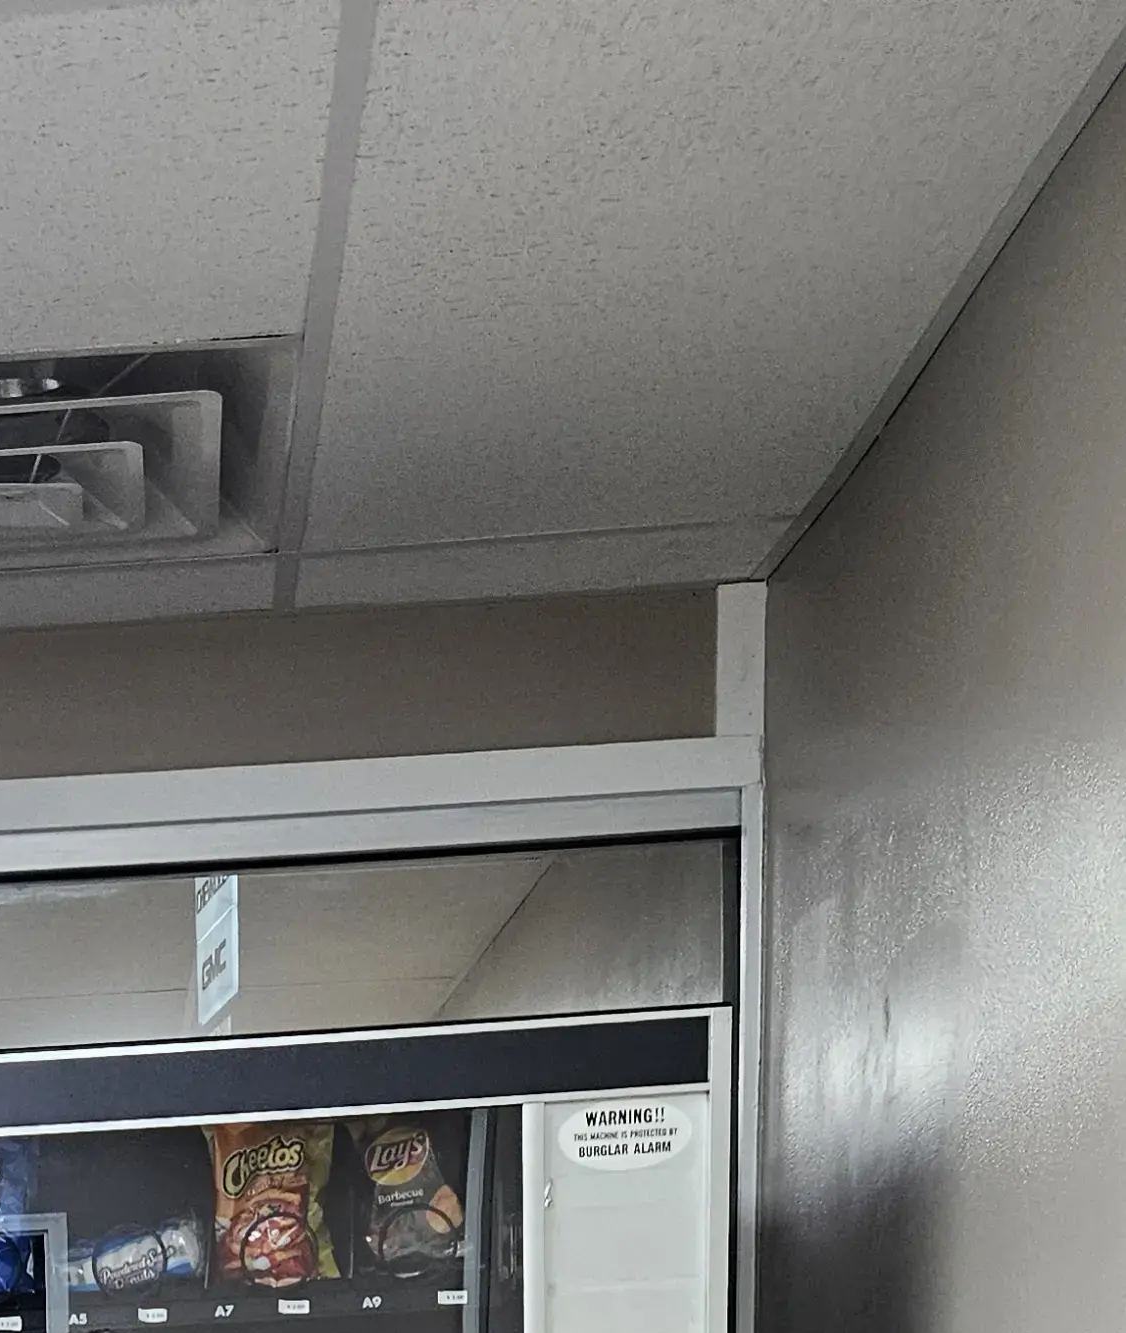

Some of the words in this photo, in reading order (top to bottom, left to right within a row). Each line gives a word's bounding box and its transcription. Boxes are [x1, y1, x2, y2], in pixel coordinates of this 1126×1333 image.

[585, 1107, 666, 1127] WARNING!!
[590, 1132, 619, 1141] MACHINE
[621, 1130, 628, 1138] IS
[630, 1128, 667, 1138] PROTECTED
[669, 1127, 678, 1136] BY
[370, 1133, 424, 1171] Lay's
[578, 1143, 629, 1158] BURGLAR
[634, 1141, 672, 1155] ALARM
[224, 1136, 304, 1198] Cheetos
[377, 1188, 424, 1205] Barbecue
[214, 1304, 234, 1317] A7
[362, 1296, 382, 1310] A9
[68, 1313, 87, 1325] A5
